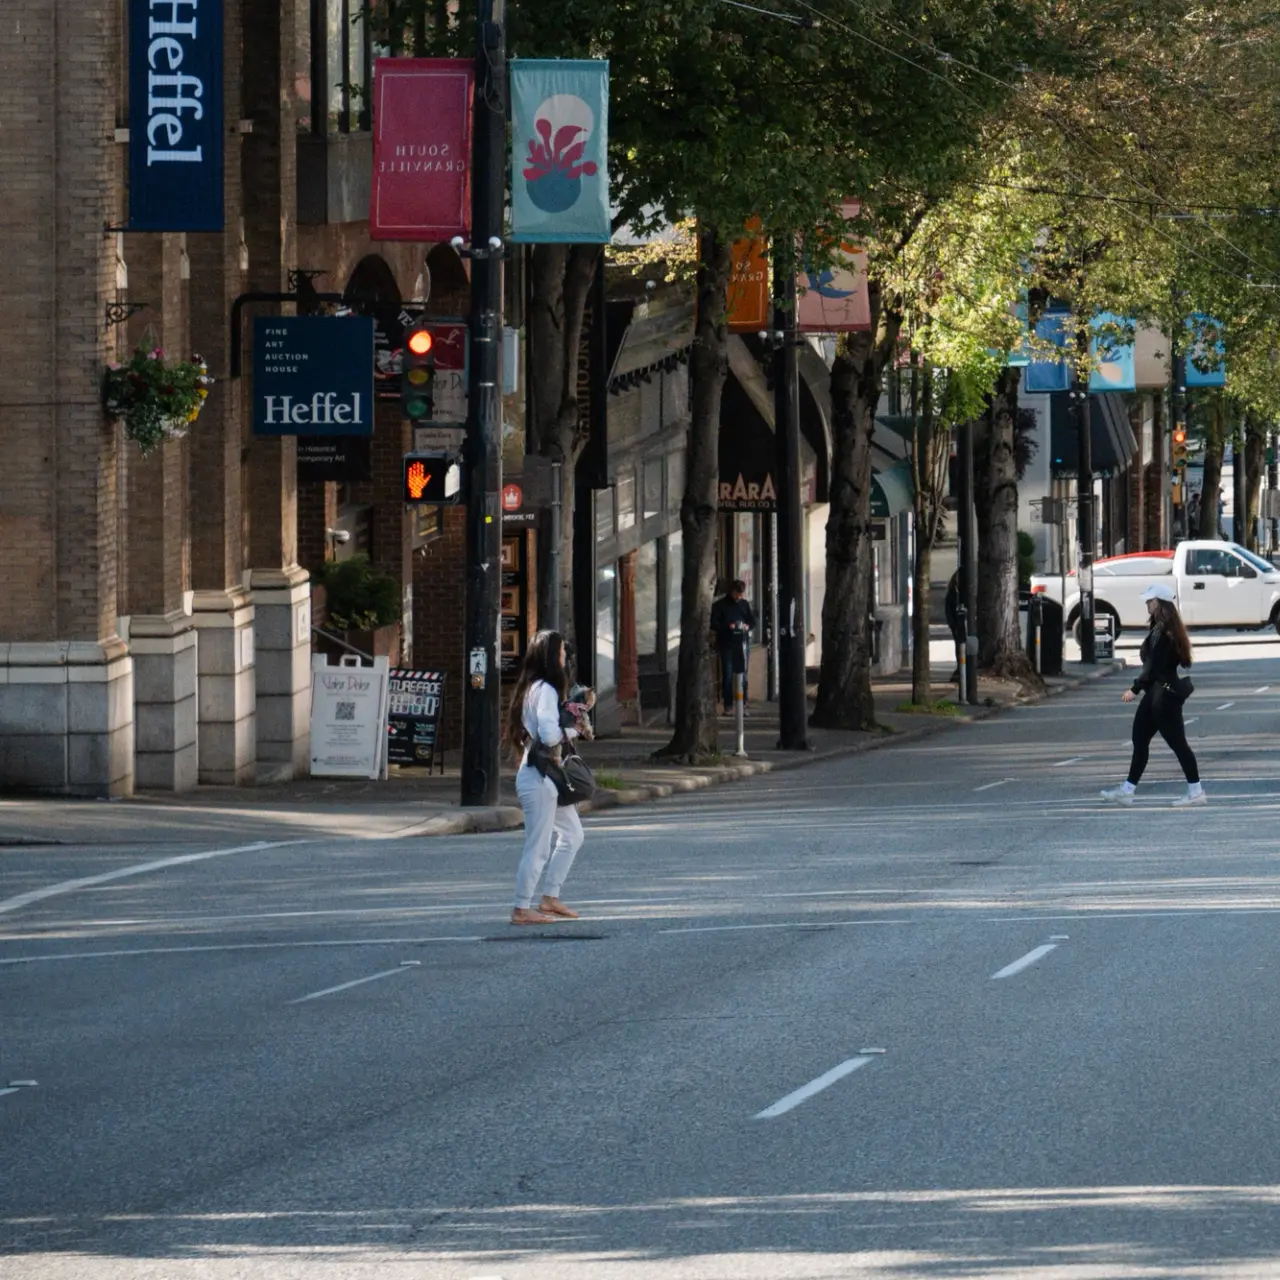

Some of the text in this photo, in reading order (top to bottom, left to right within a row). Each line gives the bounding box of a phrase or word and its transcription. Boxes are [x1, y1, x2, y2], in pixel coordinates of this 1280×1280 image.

[265, 328, 288, 336] FINE
[265, 353, 309, 361] AUCTION
[263, 392, 363, 424] Heffel
